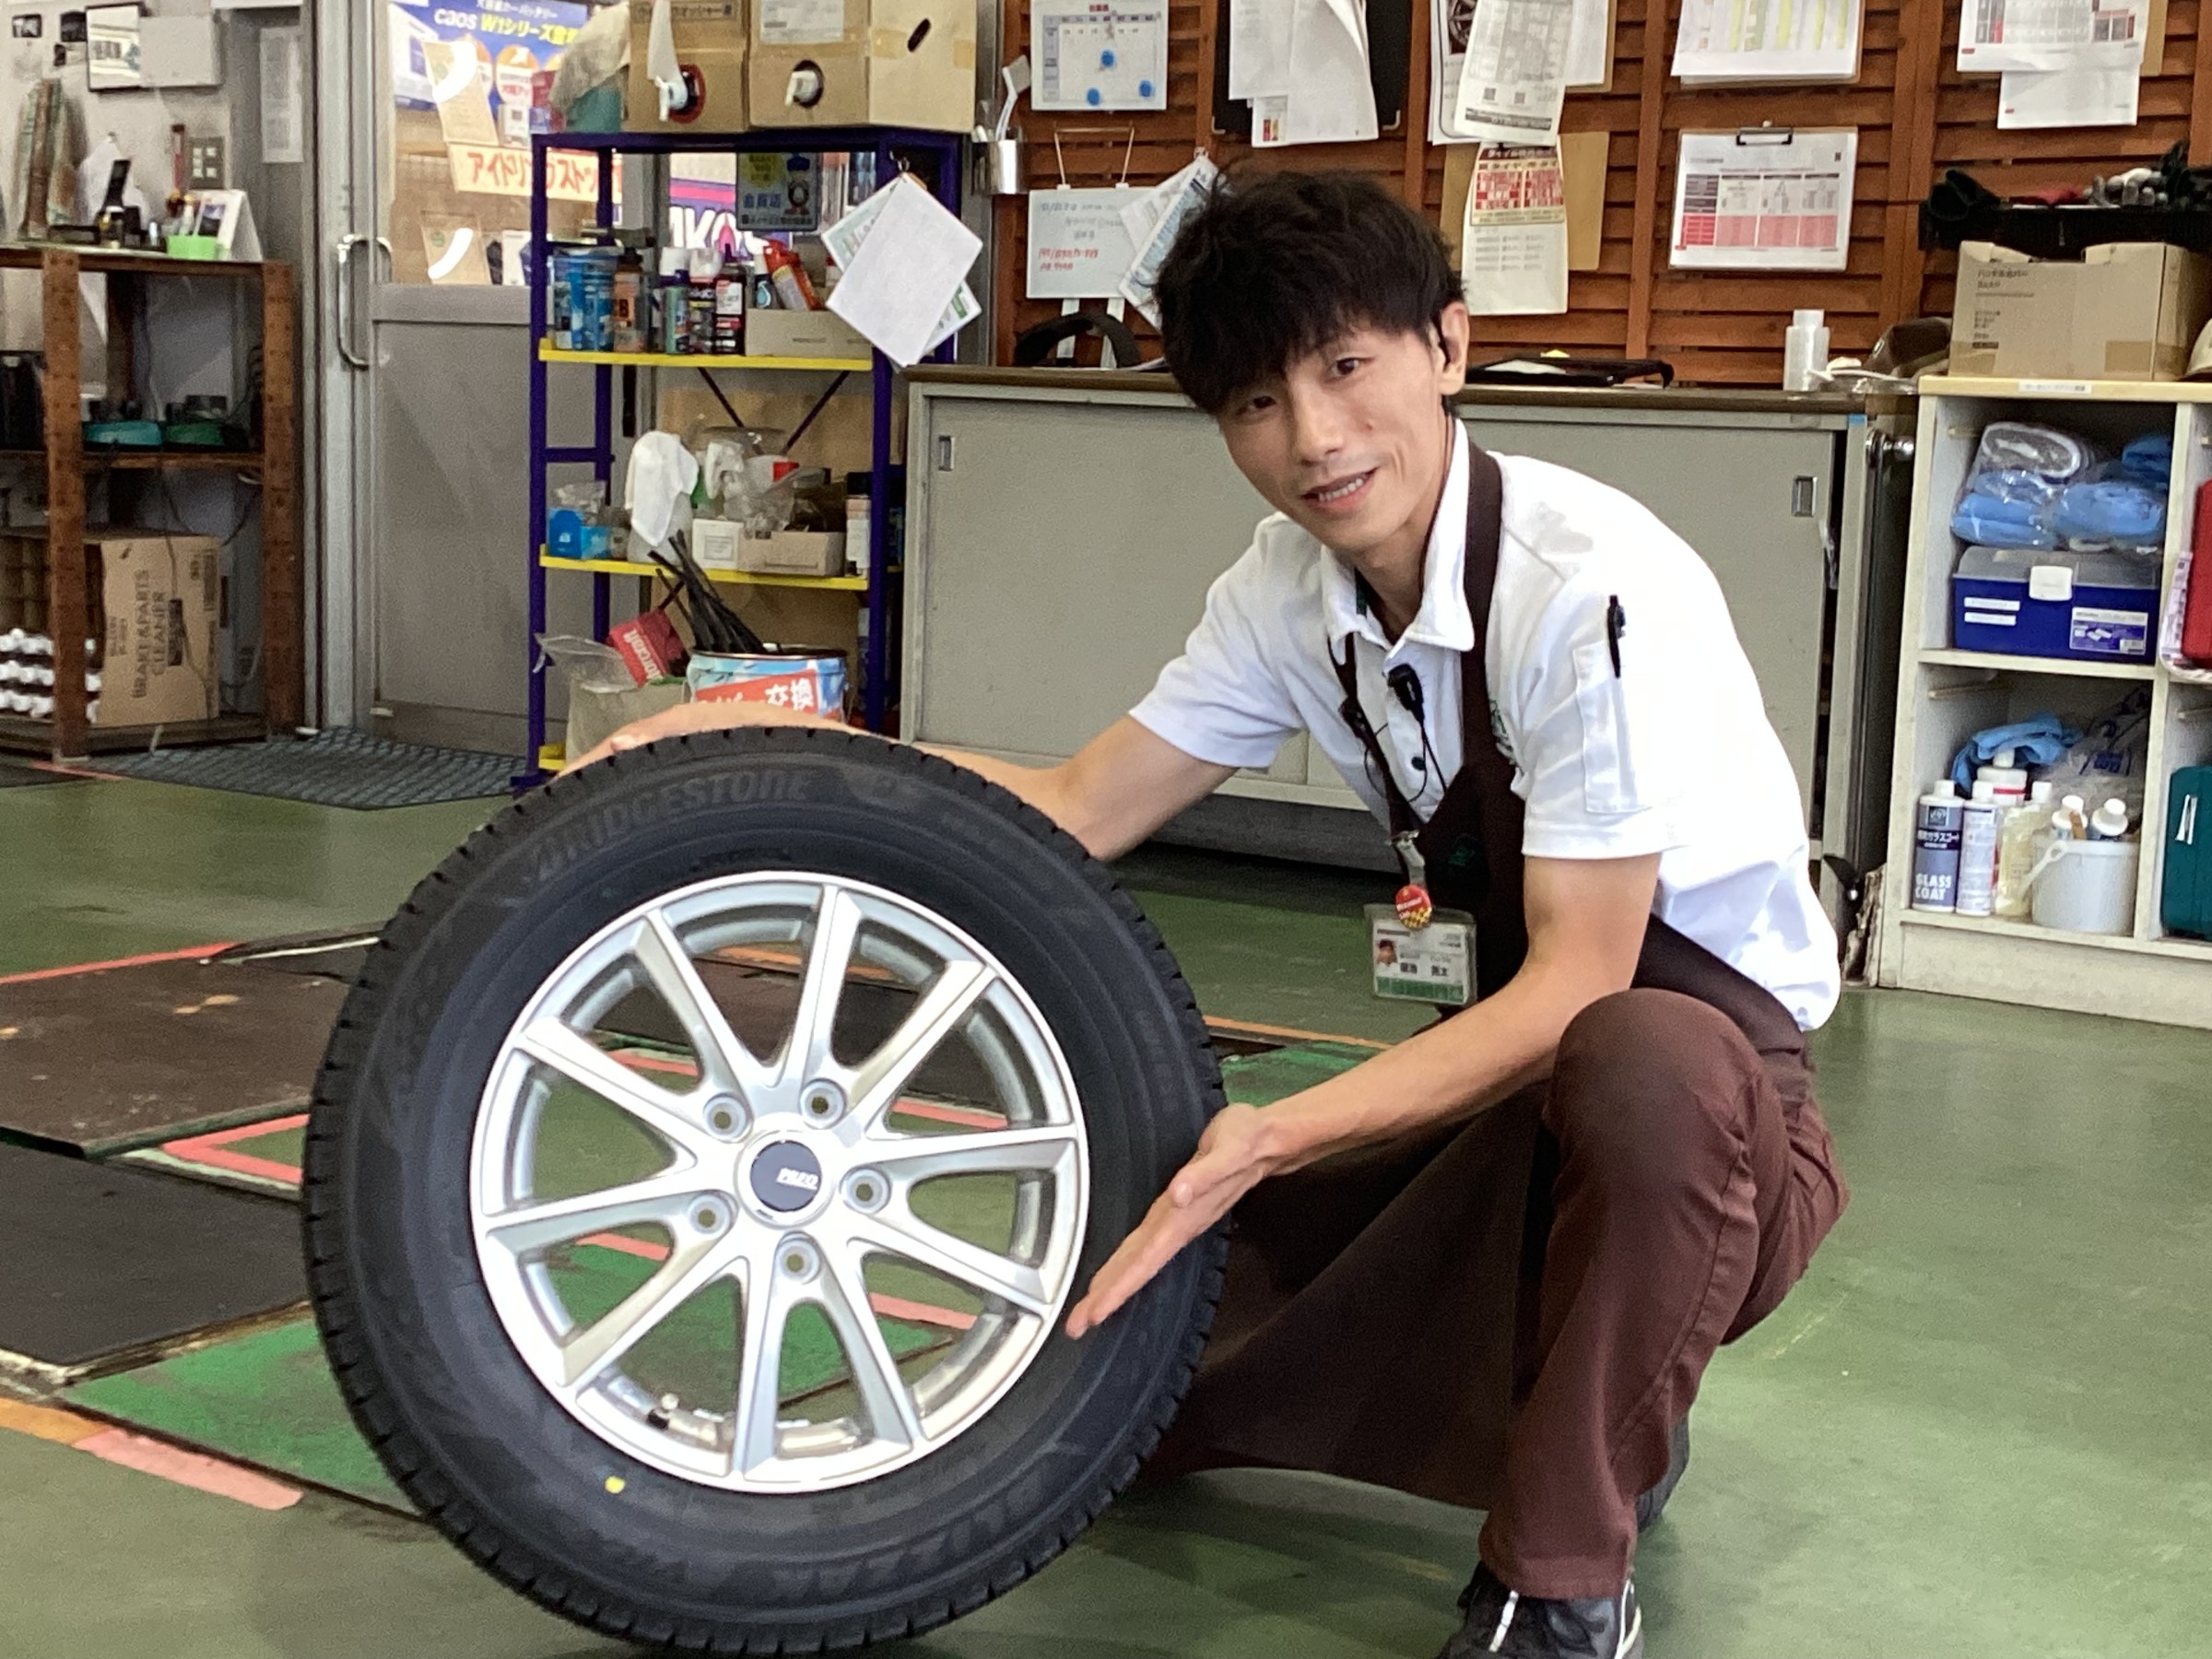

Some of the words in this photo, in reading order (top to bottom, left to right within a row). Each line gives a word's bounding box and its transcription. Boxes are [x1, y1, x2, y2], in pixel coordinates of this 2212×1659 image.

[434, 8, 477, 29] caos
[1916, 873, 1952, 888] GLASS
[1914, 886, 1947, 900] COAT
